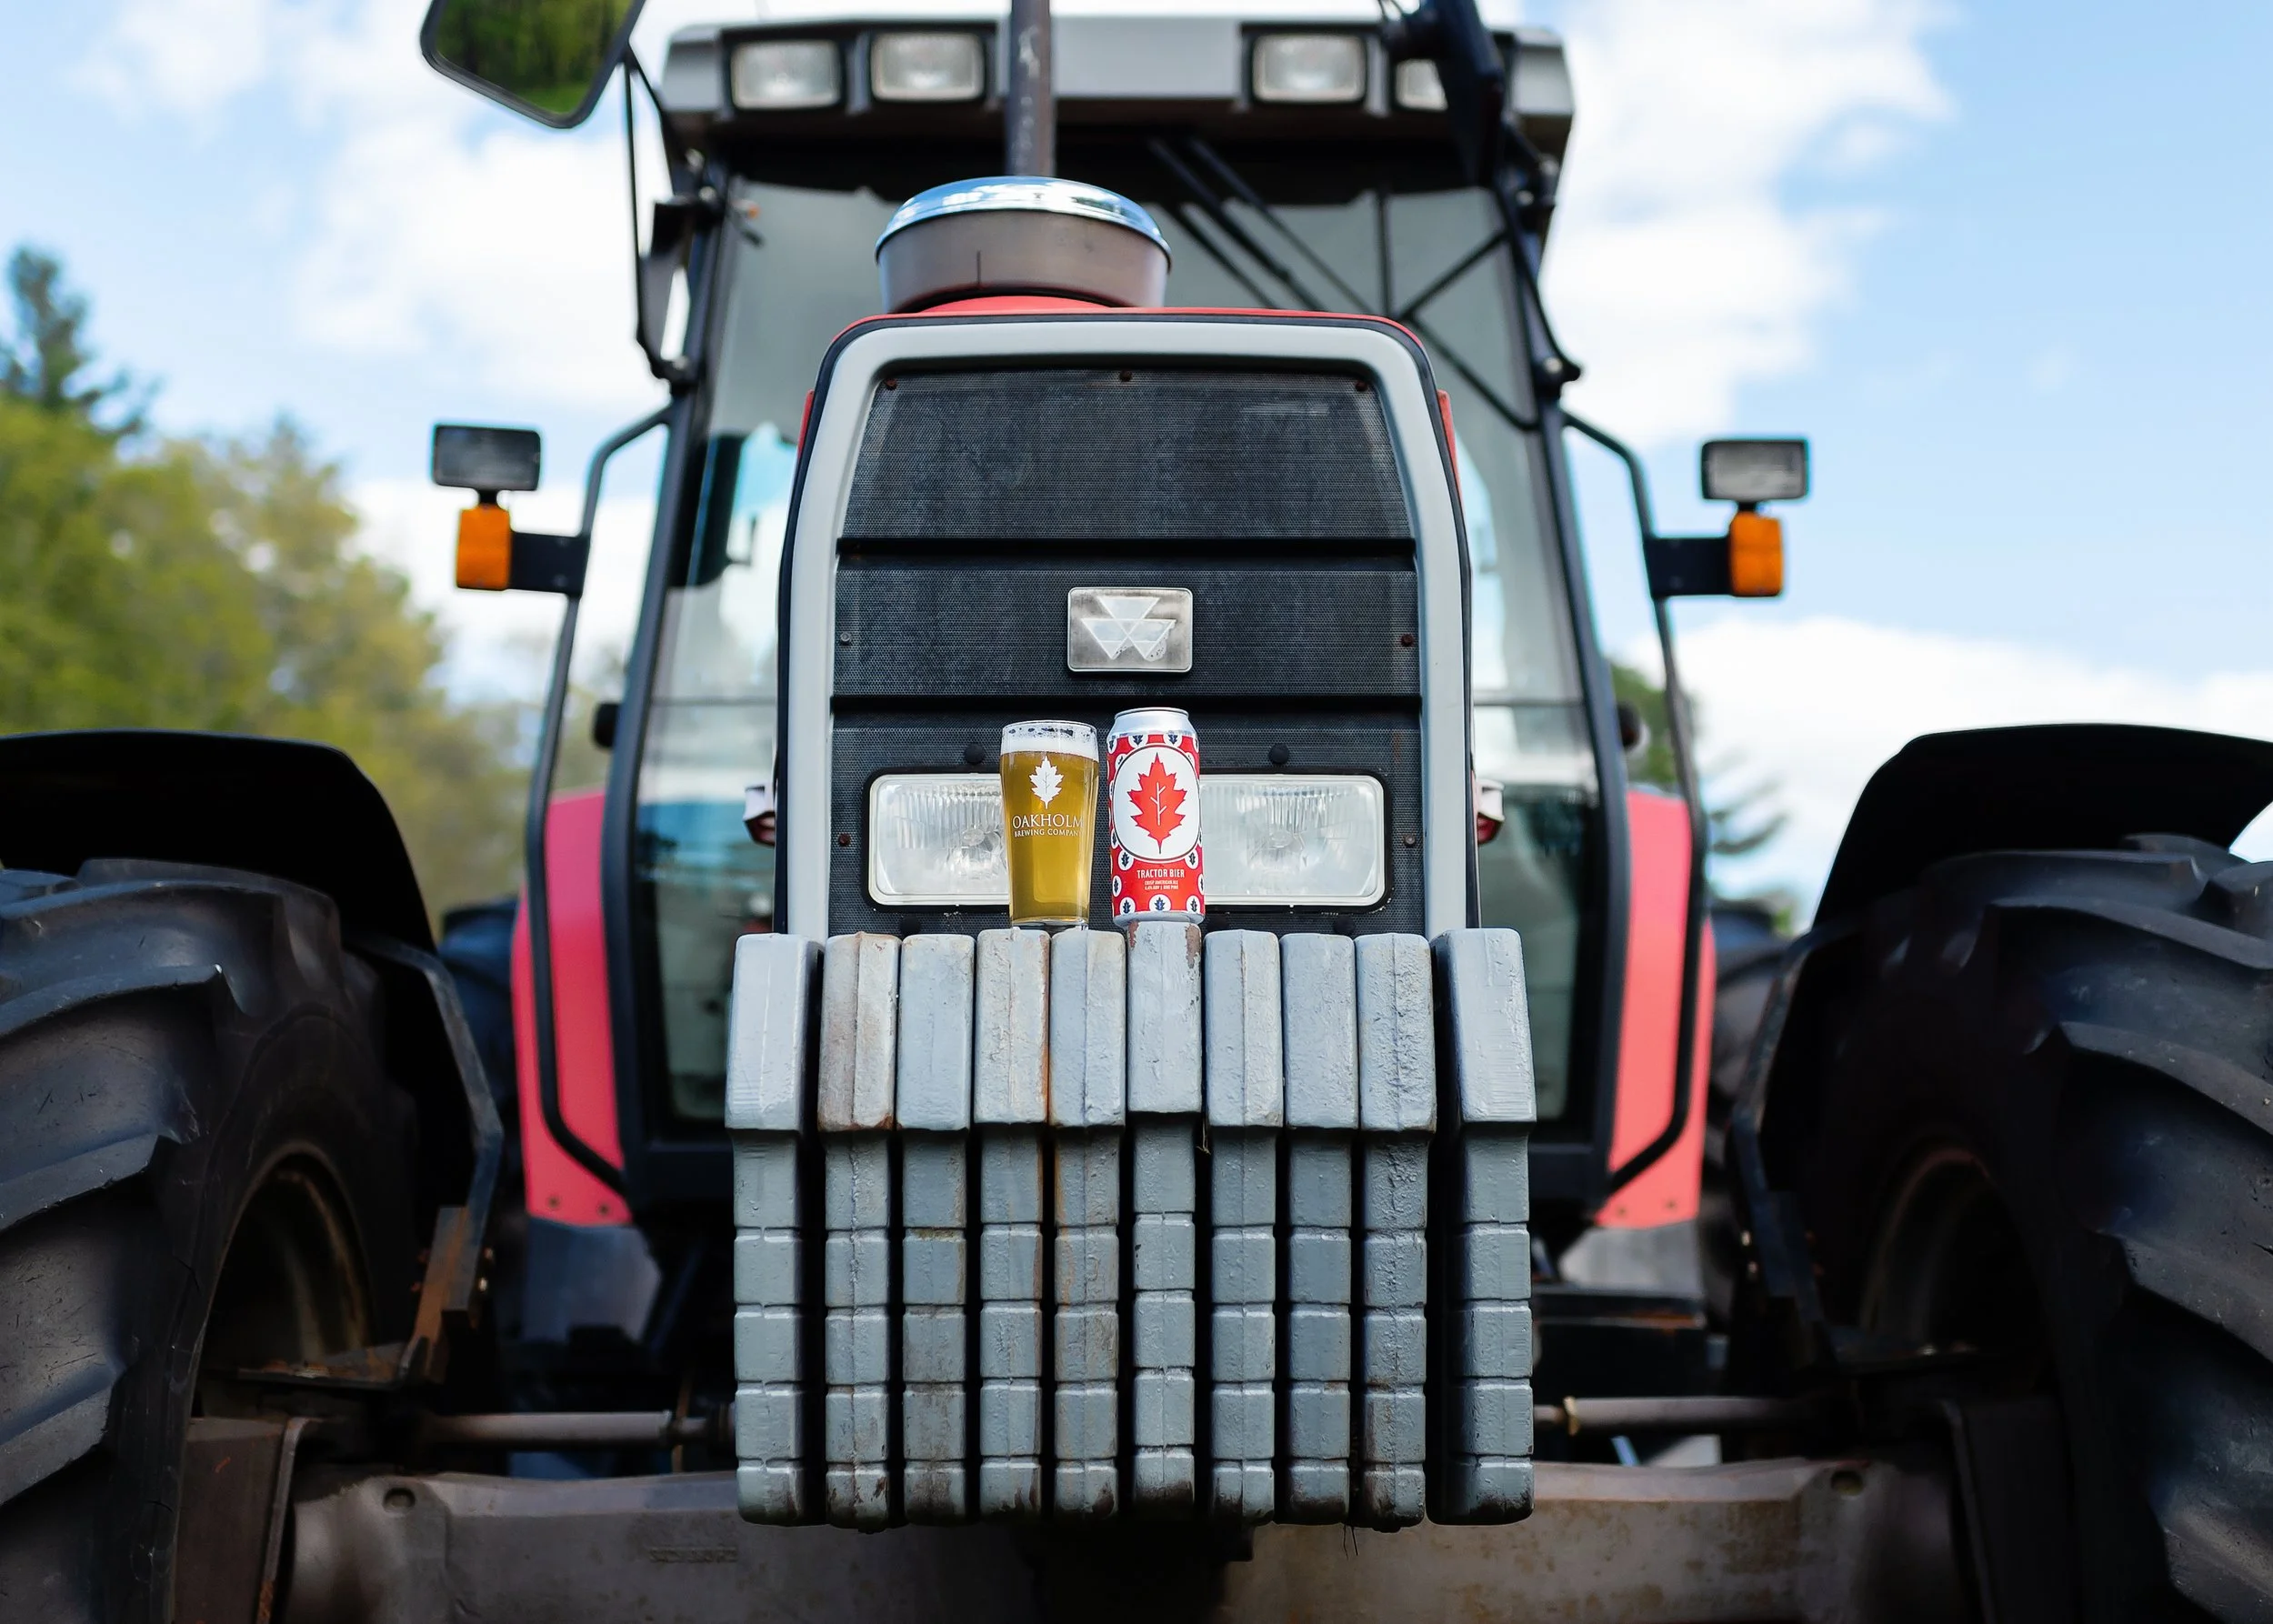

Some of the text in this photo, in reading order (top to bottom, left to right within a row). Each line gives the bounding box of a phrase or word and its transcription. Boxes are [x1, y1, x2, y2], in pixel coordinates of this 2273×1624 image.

[1012, 813, 1083, 828] OAKHOLM
[1014, 828, 1045, 837] BREWING
[1136, 868, 1185, 878] TRACTOR BIER
